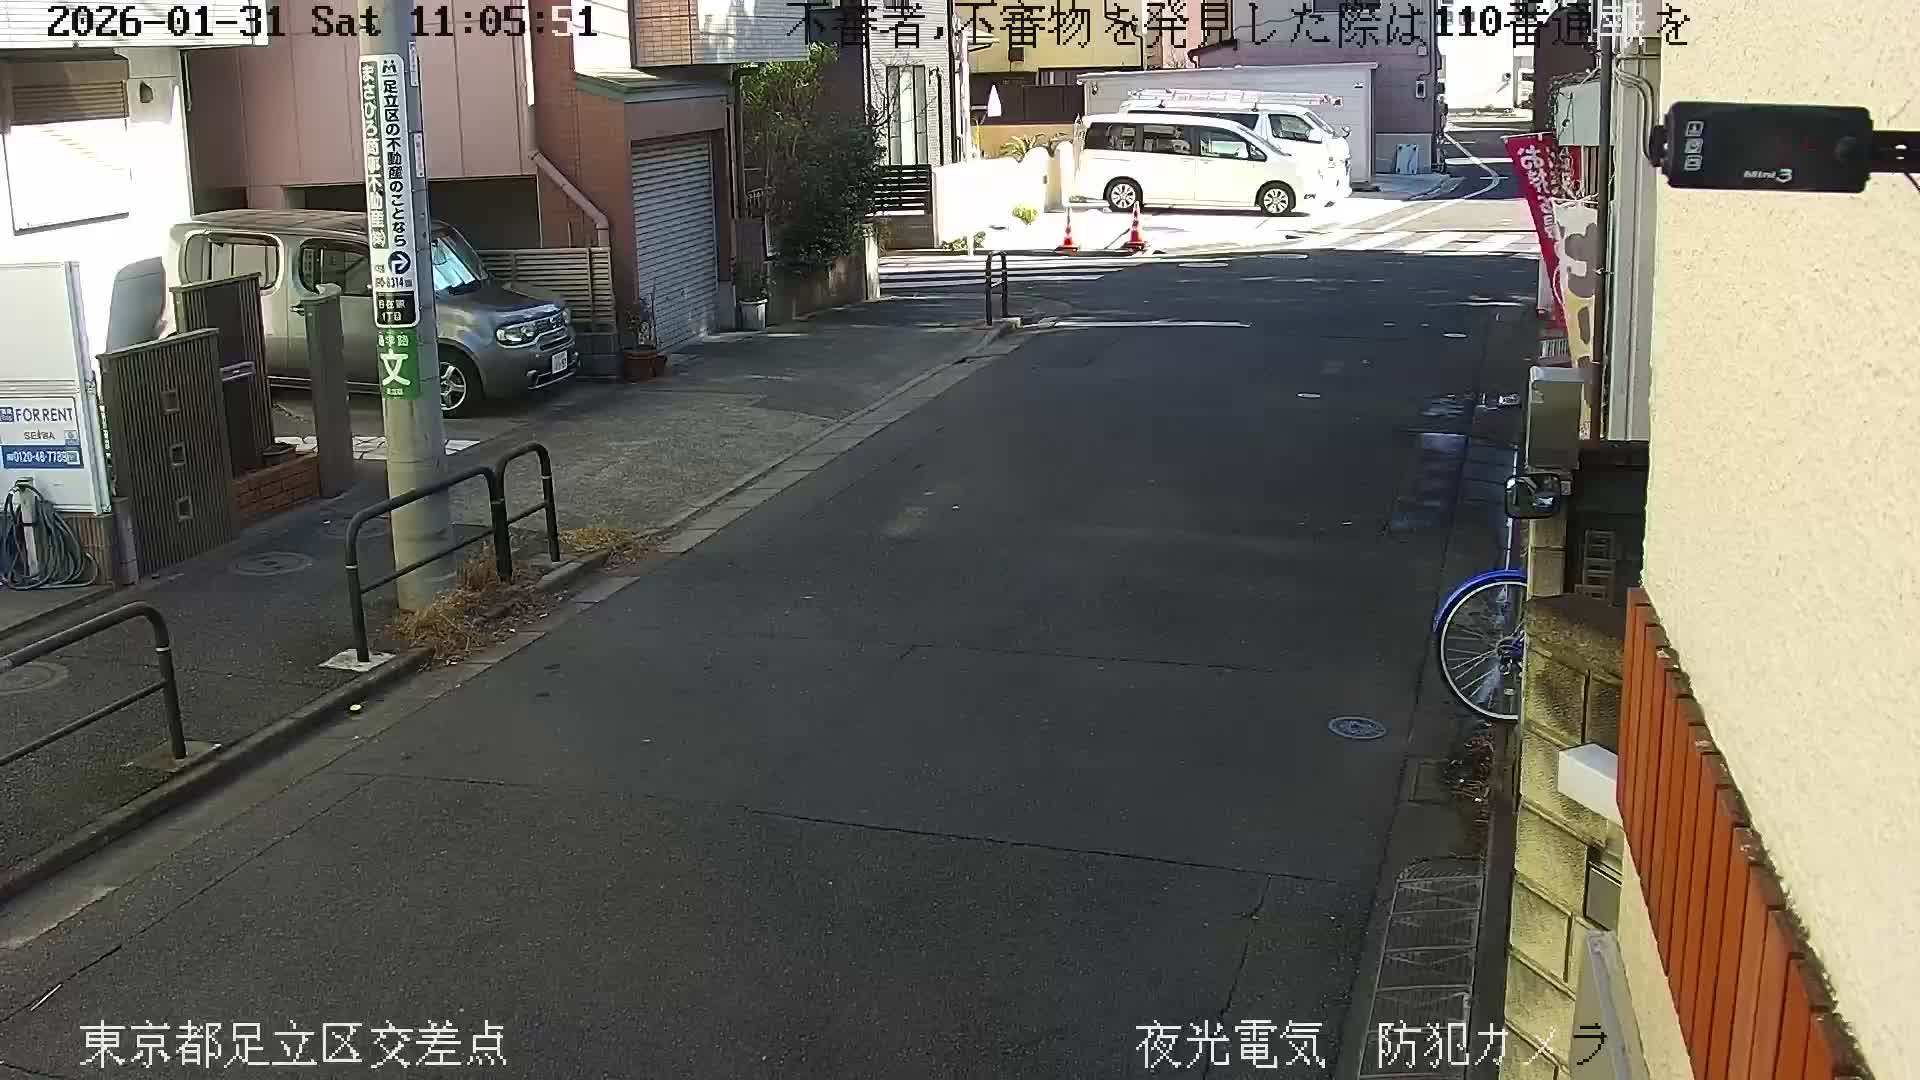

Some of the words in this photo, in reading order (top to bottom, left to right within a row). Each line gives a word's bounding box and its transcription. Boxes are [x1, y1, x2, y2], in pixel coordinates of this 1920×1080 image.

[383, 79, 408, 247] 足立区の不動産のことなら
[380, 348, 411, 386] 文
